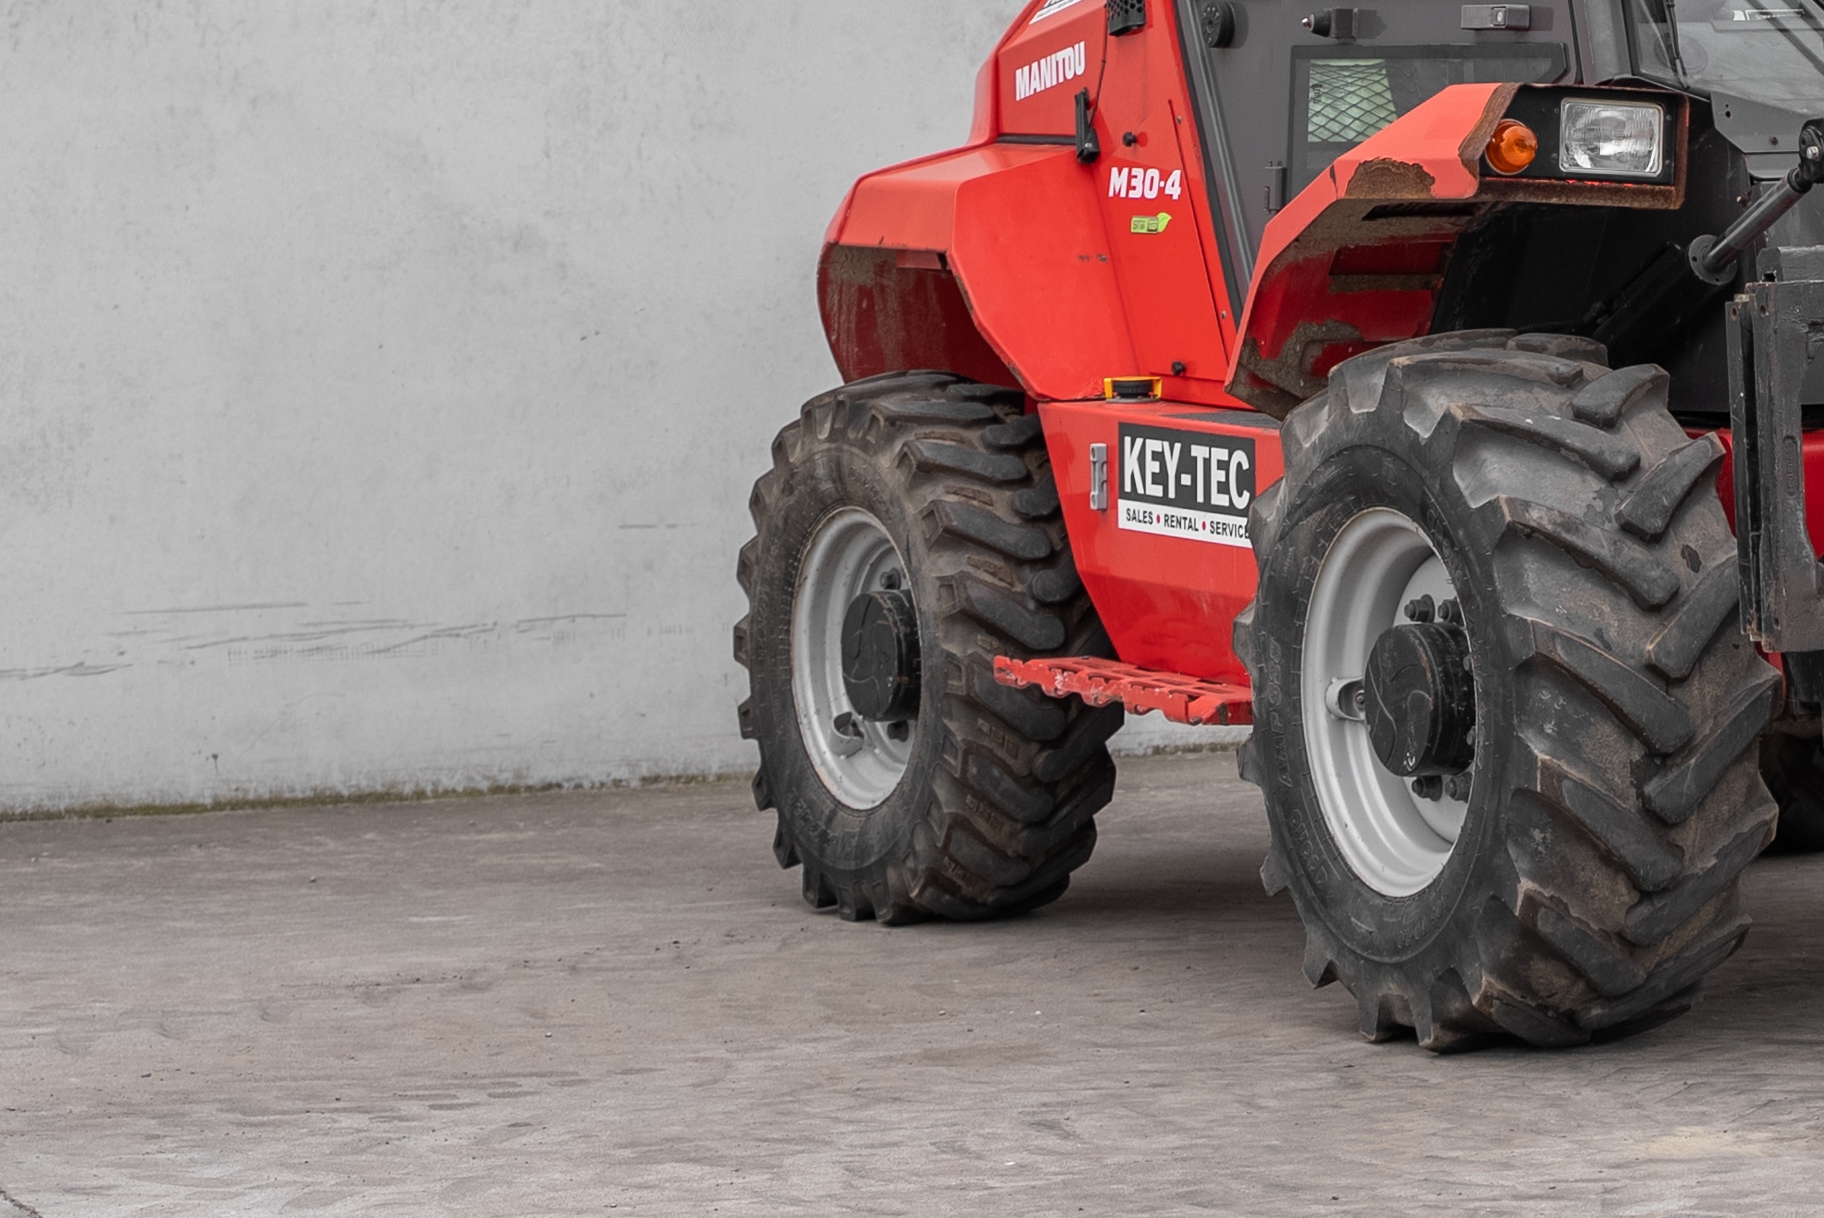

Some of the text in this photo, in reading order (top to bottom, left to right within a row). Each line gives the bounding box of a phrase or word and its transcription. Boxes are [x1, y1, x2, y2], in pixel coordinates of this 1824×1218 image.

[1015, 41, 1086, 101] MANITOU
[1124, 435, 1250, 510] KEY-TEC
[1125, 507, 1154, 525] SALES
[1163, 513, 1199, 532] RENTAL
